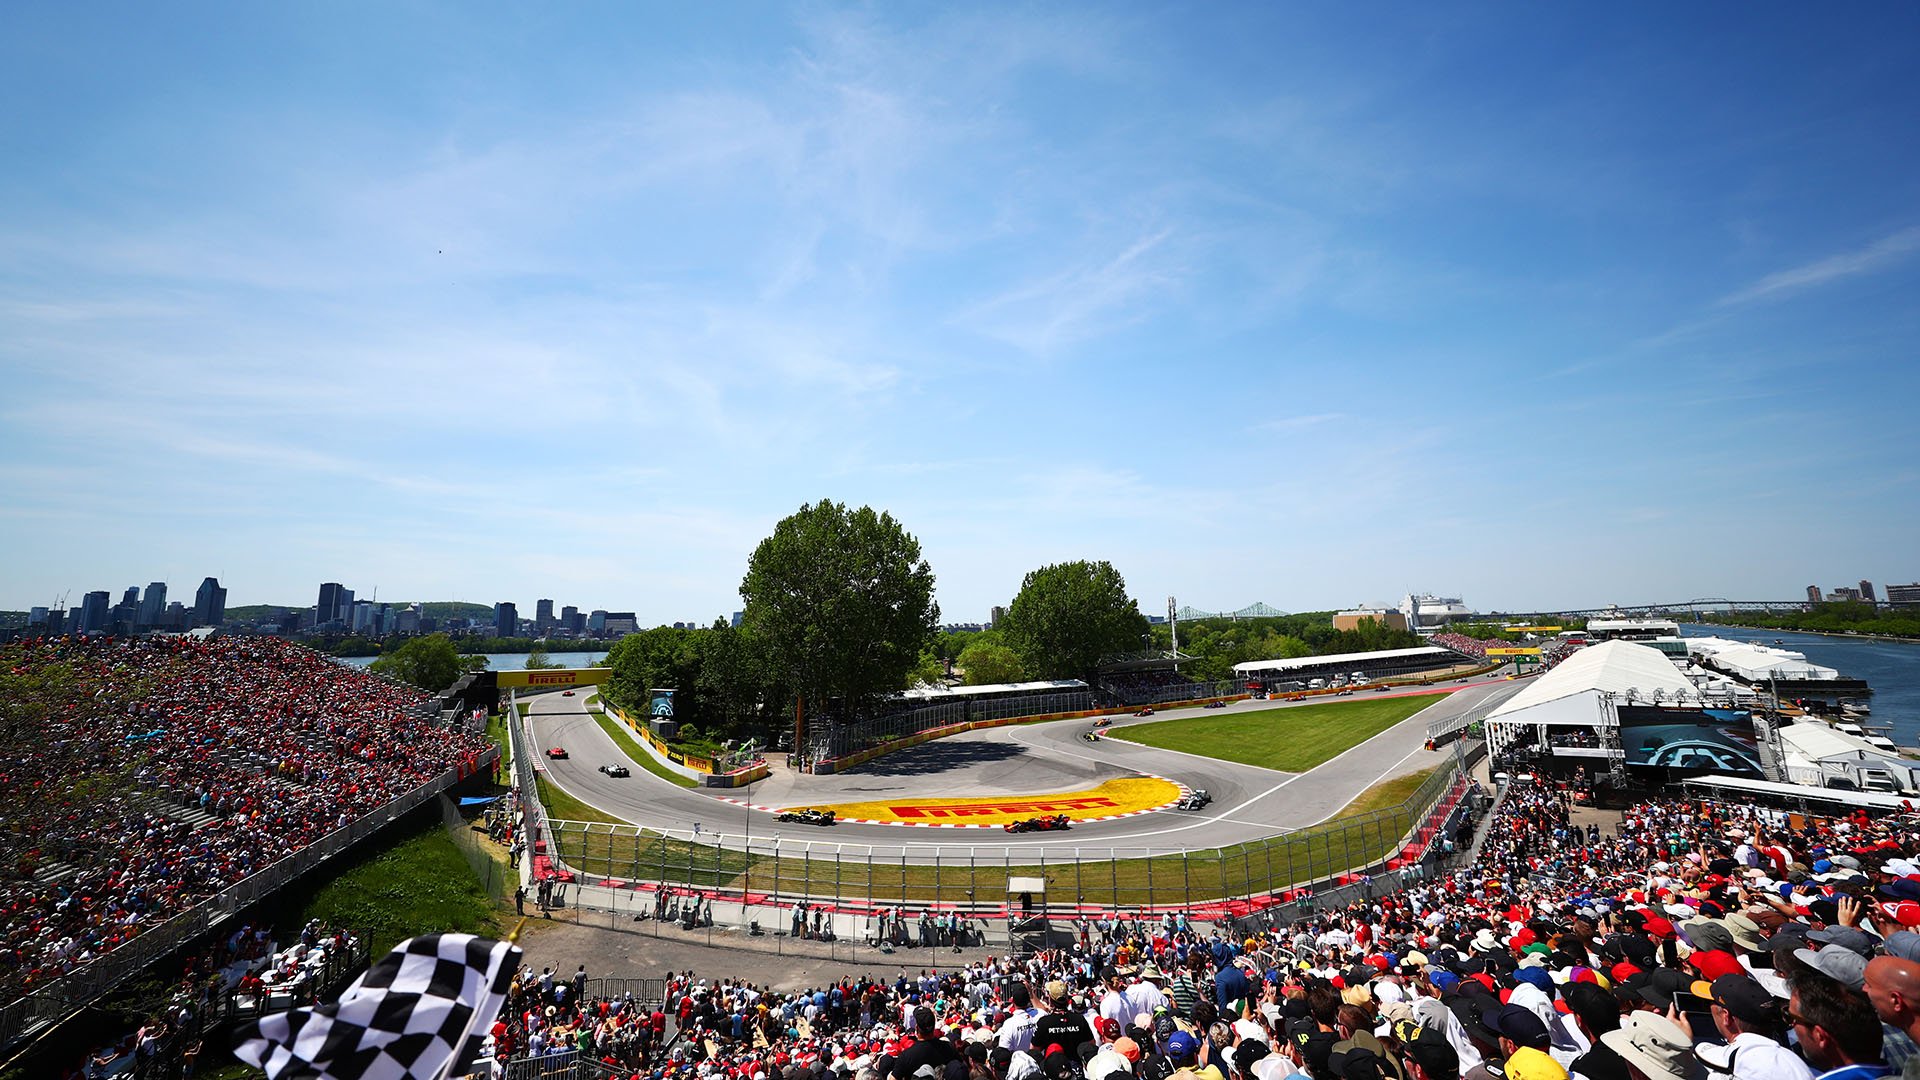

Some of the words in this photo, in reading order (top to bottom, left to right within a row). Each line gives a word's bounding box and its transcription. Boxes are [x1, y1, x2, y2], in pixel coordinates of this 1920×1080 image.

[528, 672, 577, 684] PIRELLI
[670, 752, 683, 761] ZERO
[889, 797, 1120, 818] PIRELLI
